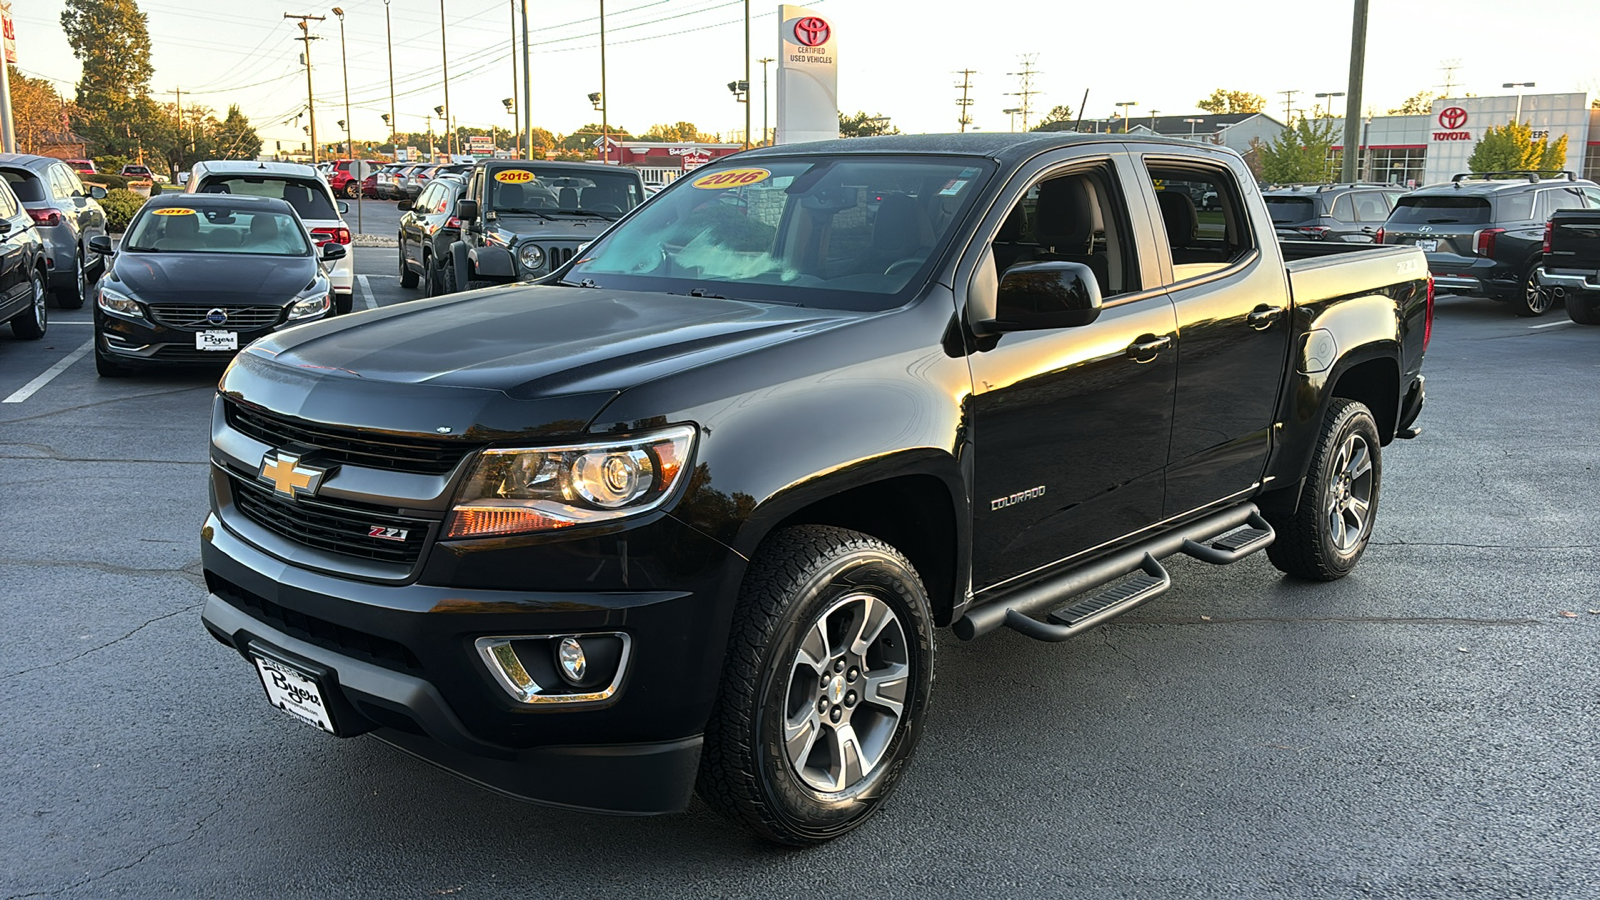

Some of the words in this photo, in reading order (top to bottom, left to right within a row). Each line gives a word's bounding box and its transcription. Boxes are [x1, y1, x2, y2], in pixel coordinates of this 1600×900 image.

[797, 46, 826, 55] CERTIFIED
[790, 54, 806, 63] USED
[806, 56, 833, 64] VEHICLES
[1432, 131, 1471, 141] TOYOTA
[500, 173, 530, 181] 2015
[698, 171, 764, 186] 2016
[990, 485, 1046, 512] COLORADO
[368, 525, 409, 542] Z71
[263, 666, 322, 707] Byers
